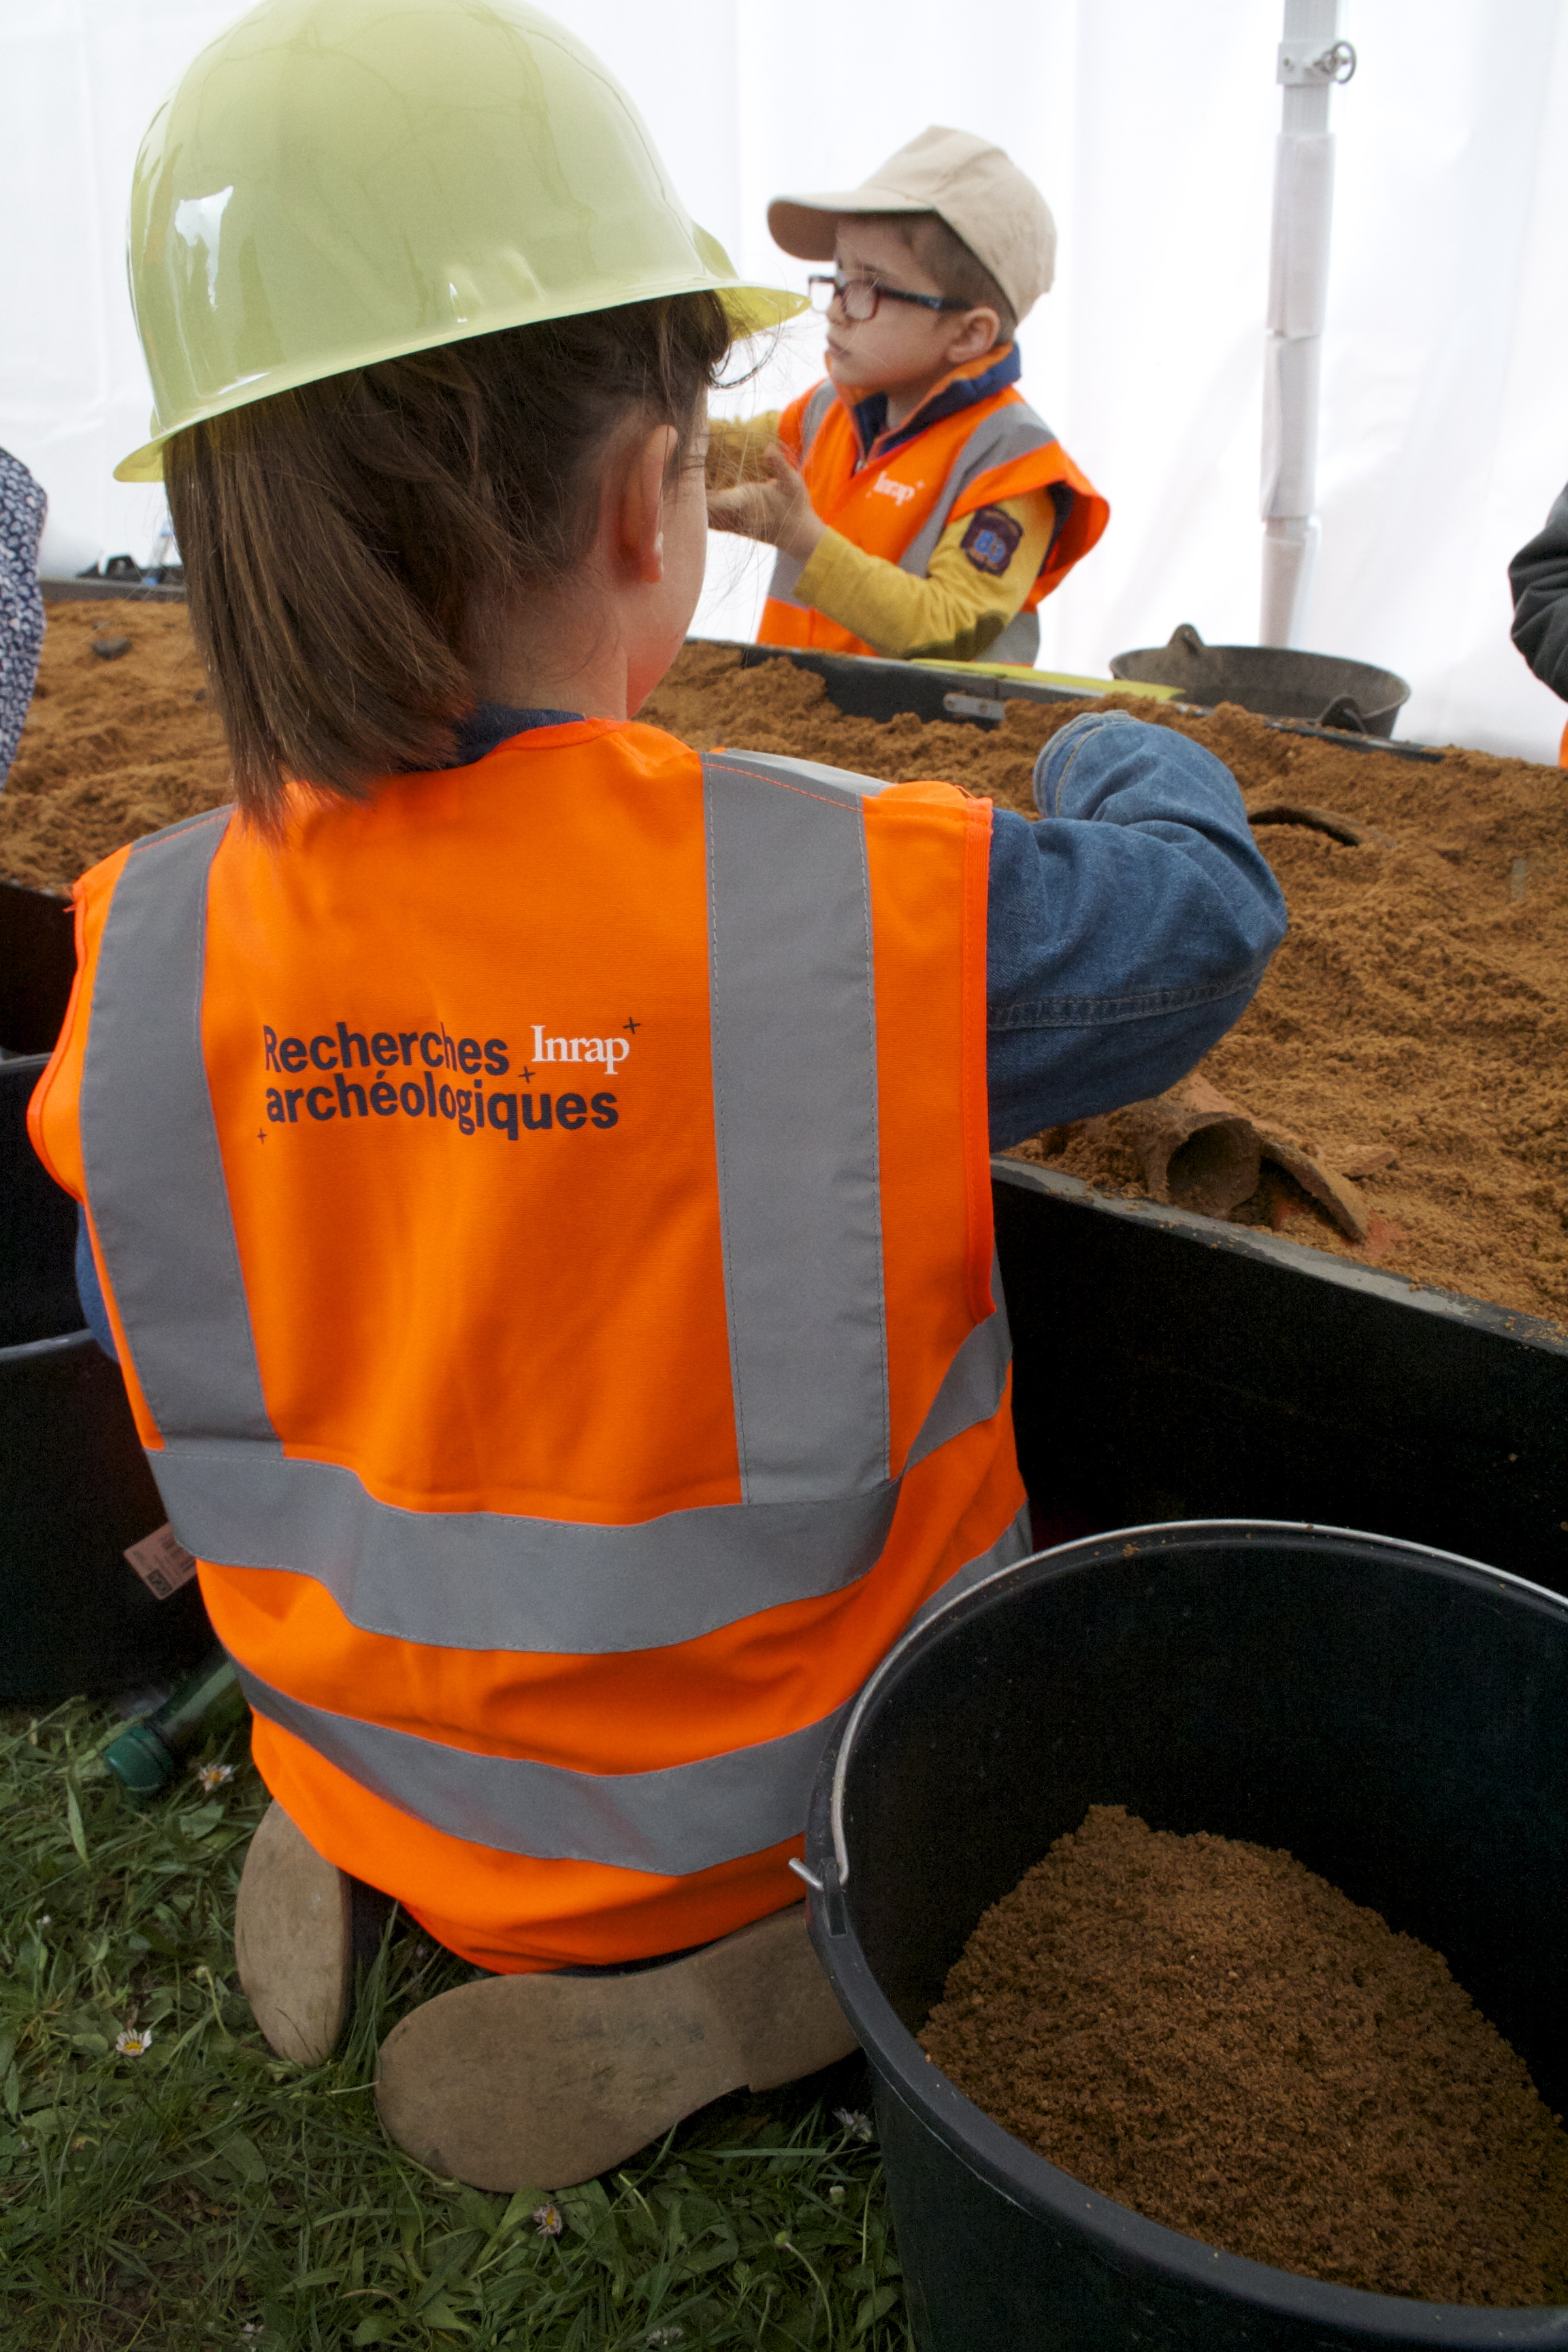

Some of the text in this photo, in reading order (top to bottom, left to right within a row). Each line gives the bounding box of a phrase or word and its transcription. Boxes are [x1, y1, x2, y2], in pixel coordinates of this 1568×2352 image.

[263, 1022, 510, 1077] Recherches
[530, 1025, 630, 1075] Inrap
[265, 1070, 619, 1141] archéologiques
